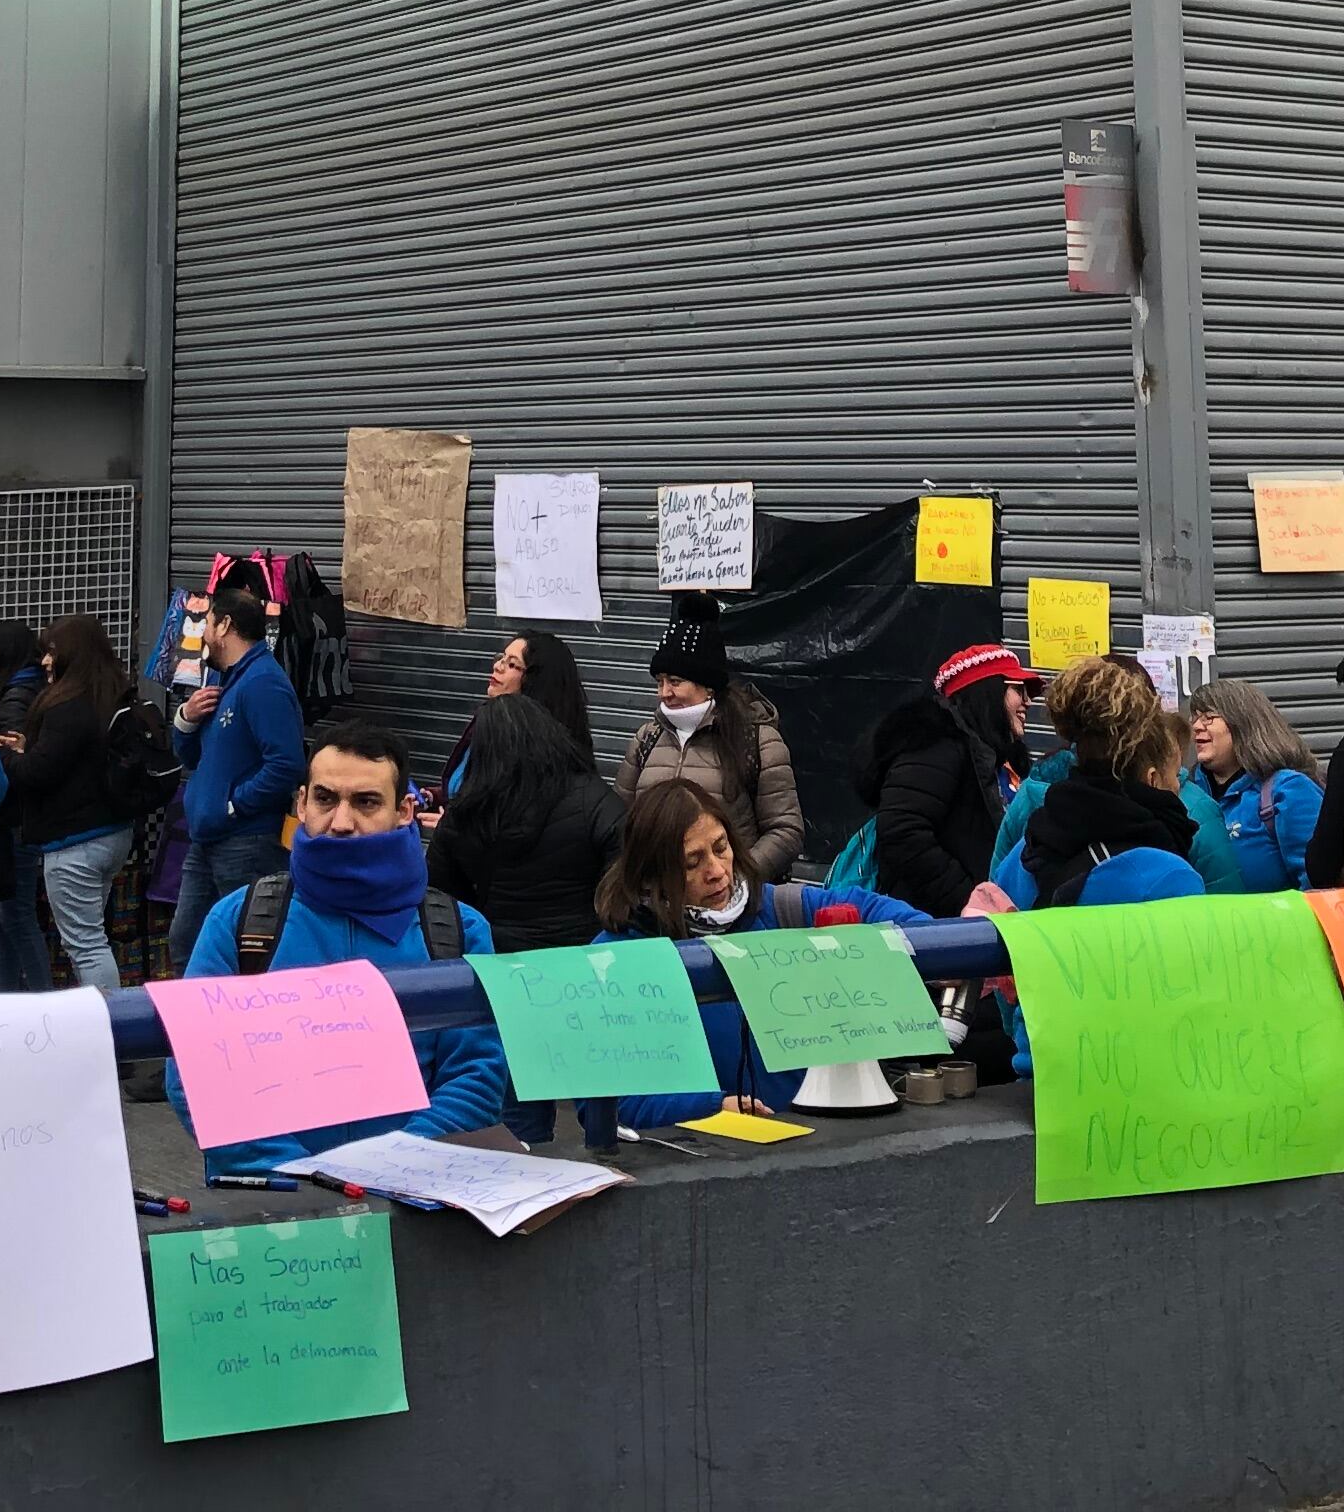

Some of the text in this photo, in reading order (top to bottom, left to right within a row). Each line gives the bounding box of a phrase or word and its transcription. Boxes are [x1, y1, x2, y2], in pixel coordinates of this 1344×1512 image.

[201, 976, 365, 1016] Muchos Jefes
[508, 965, 667, 1008] Basta en
[769, 975, 889, 1018] Crueles
[23, 1013, 58, 1055] el
[242, 1030, 284, 1063] poco
[286, 1014, 374, 1039] Personal
[565, 1009, 584, 1033] el
[1076, 1025, 1139, 1097] NO
[1085, 1103, 1318, 1185] NEGOCIAR
[189, 1251, 246, 1286] Mas
[233, 1298, 248, 1320] el
[216, 1353, 252, 1376] ante
[261, 1344, 280, 1367] la
